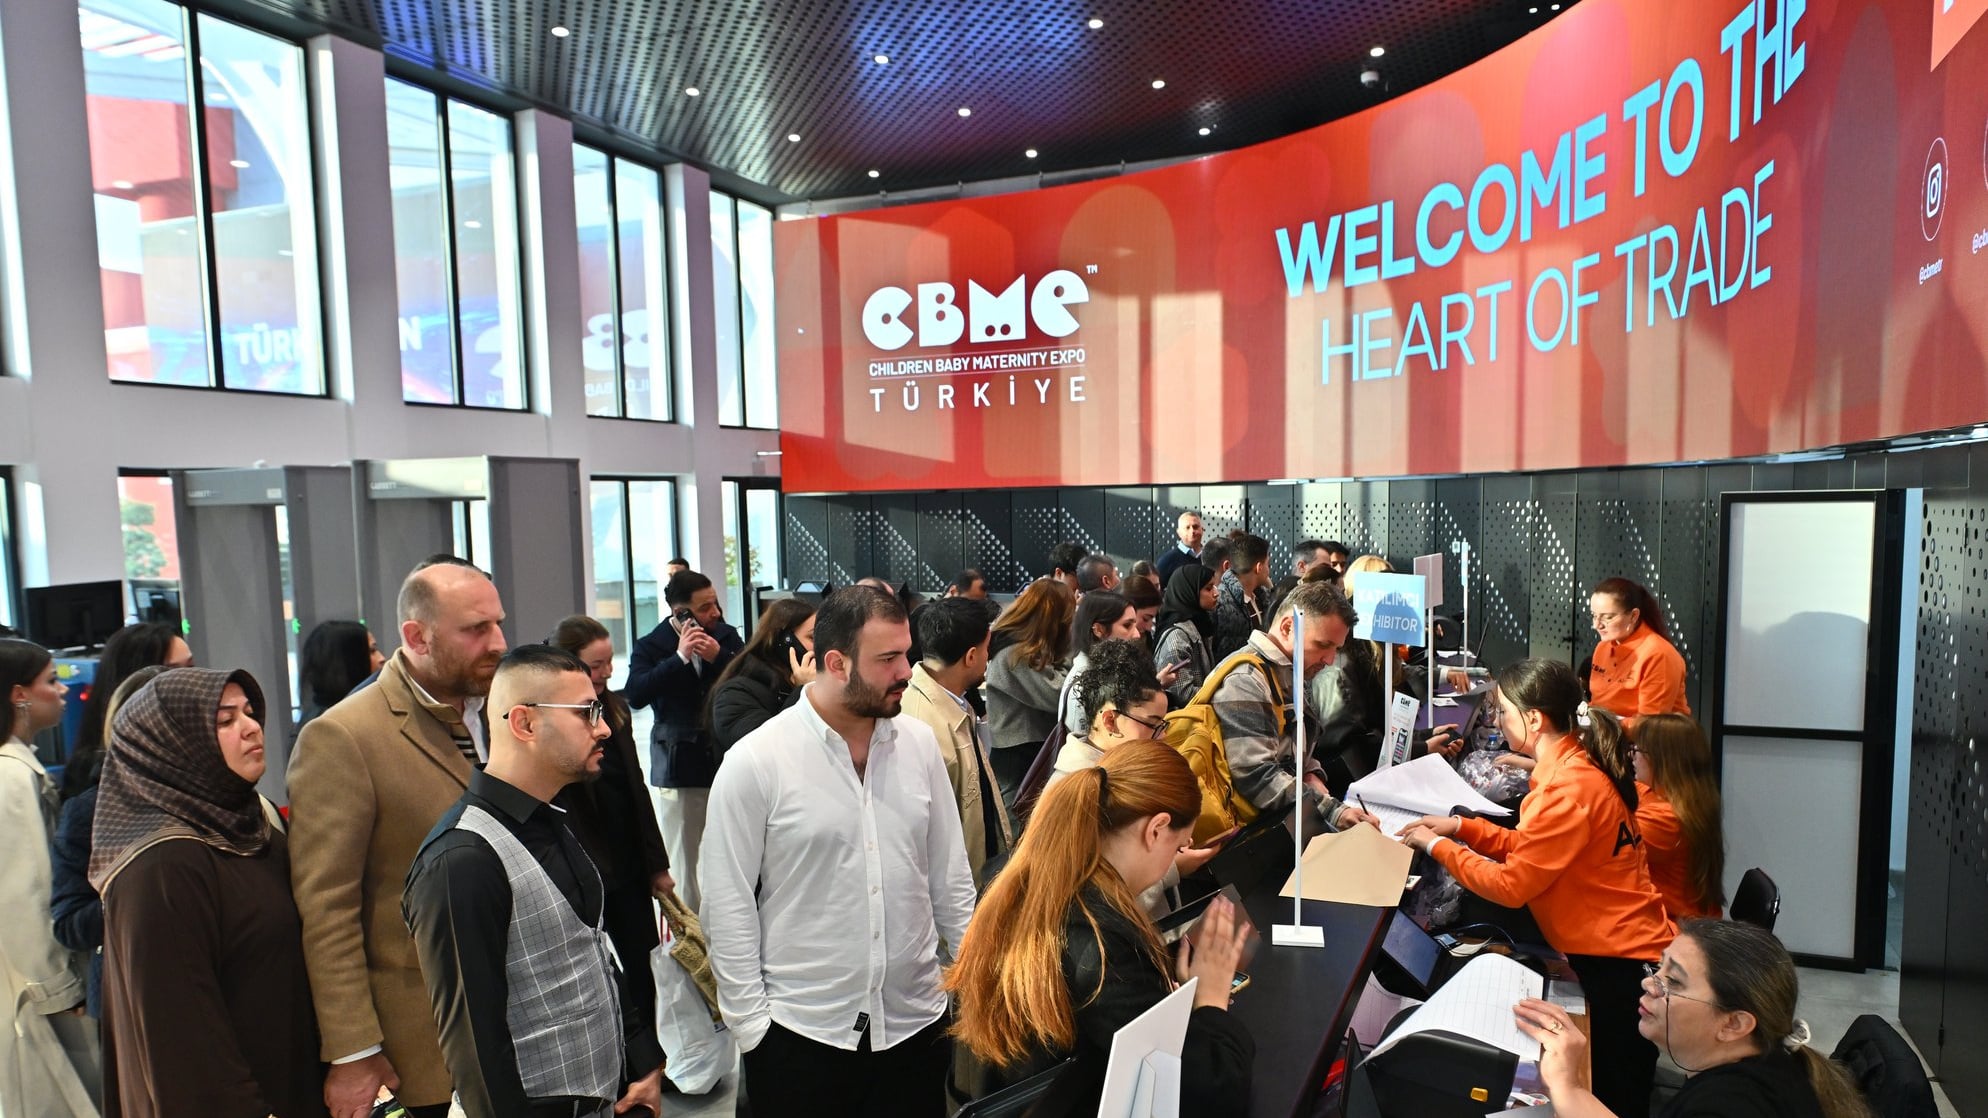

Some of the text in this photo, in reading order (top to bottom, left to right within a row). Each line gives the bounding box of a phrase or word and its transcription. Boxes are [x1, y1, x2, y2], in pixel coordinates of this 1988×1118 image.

[1275, 0, 1806, 298] WELCOME TO THE
[1322, 159, 1775, 385] HEART OF TRADE
[869, 348, 1085, 377] CHILDREN BABY MATERNITY EXPO
[869, 375, 1086, 413] TÜRKİYE
